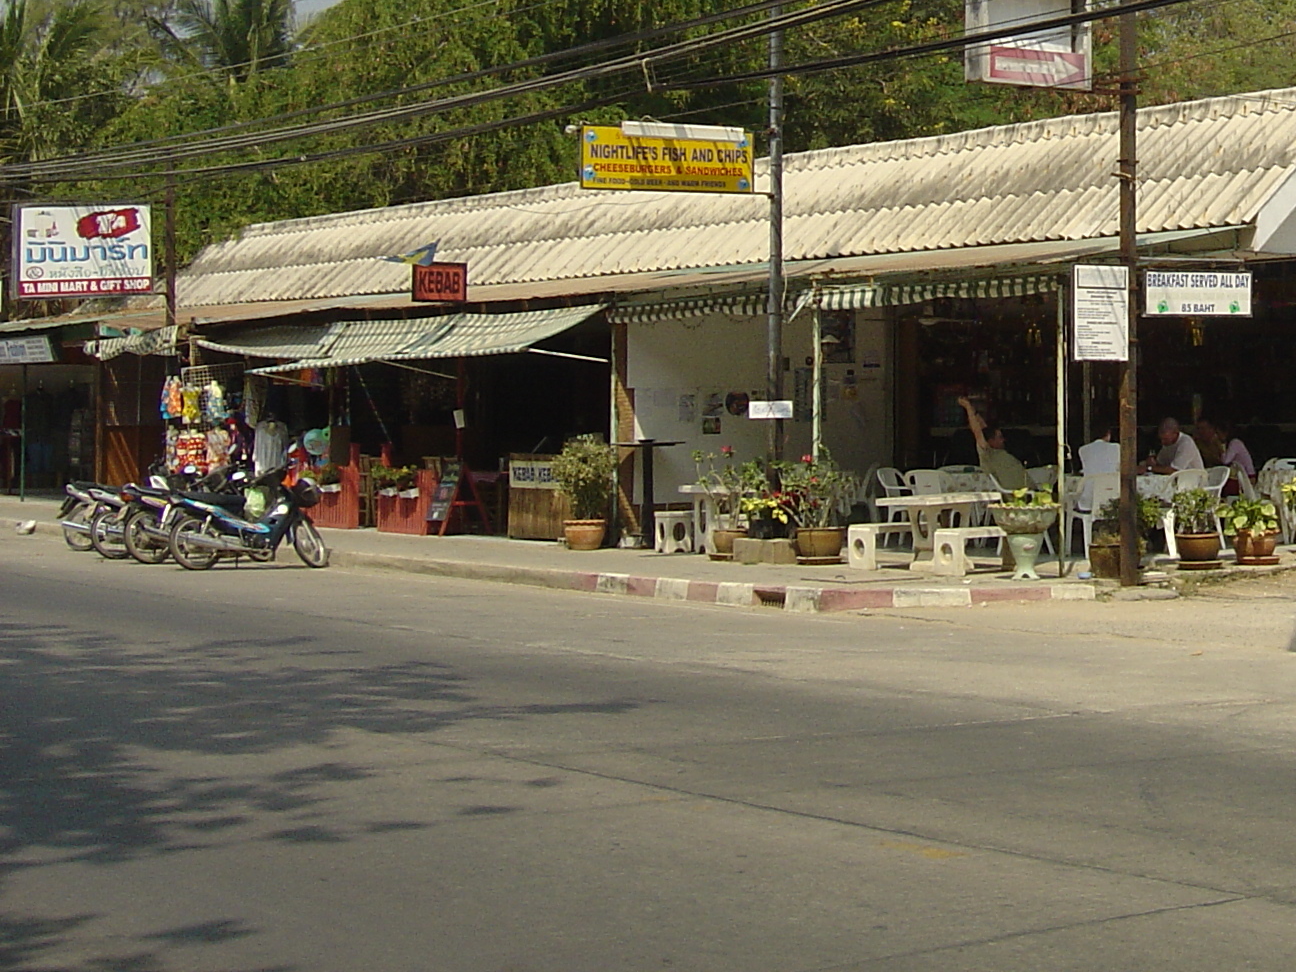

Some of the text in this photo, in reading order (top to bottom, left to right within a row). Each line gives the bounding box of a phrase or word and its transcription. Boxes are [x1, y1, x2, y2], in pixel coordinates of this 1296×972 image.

[590, 144, 748, 164] NIGHTLIFE'S FISH AND CHIPS
[593, 162, 743, 177] CHEESEBURGERS & SANDWICHES
[700, 179, 726, 188] FRIENDS
[96, 212, 127, 234] TA
[22, 279, 150, 294] TA MINI MART & GIFT SHOP
[418, 270, 461, 294] KEBAB
[1147, 272, 1249, 289] BREAKFAST SERVED ALL DAY
[1193, 303, 1215, 313] BAHT
